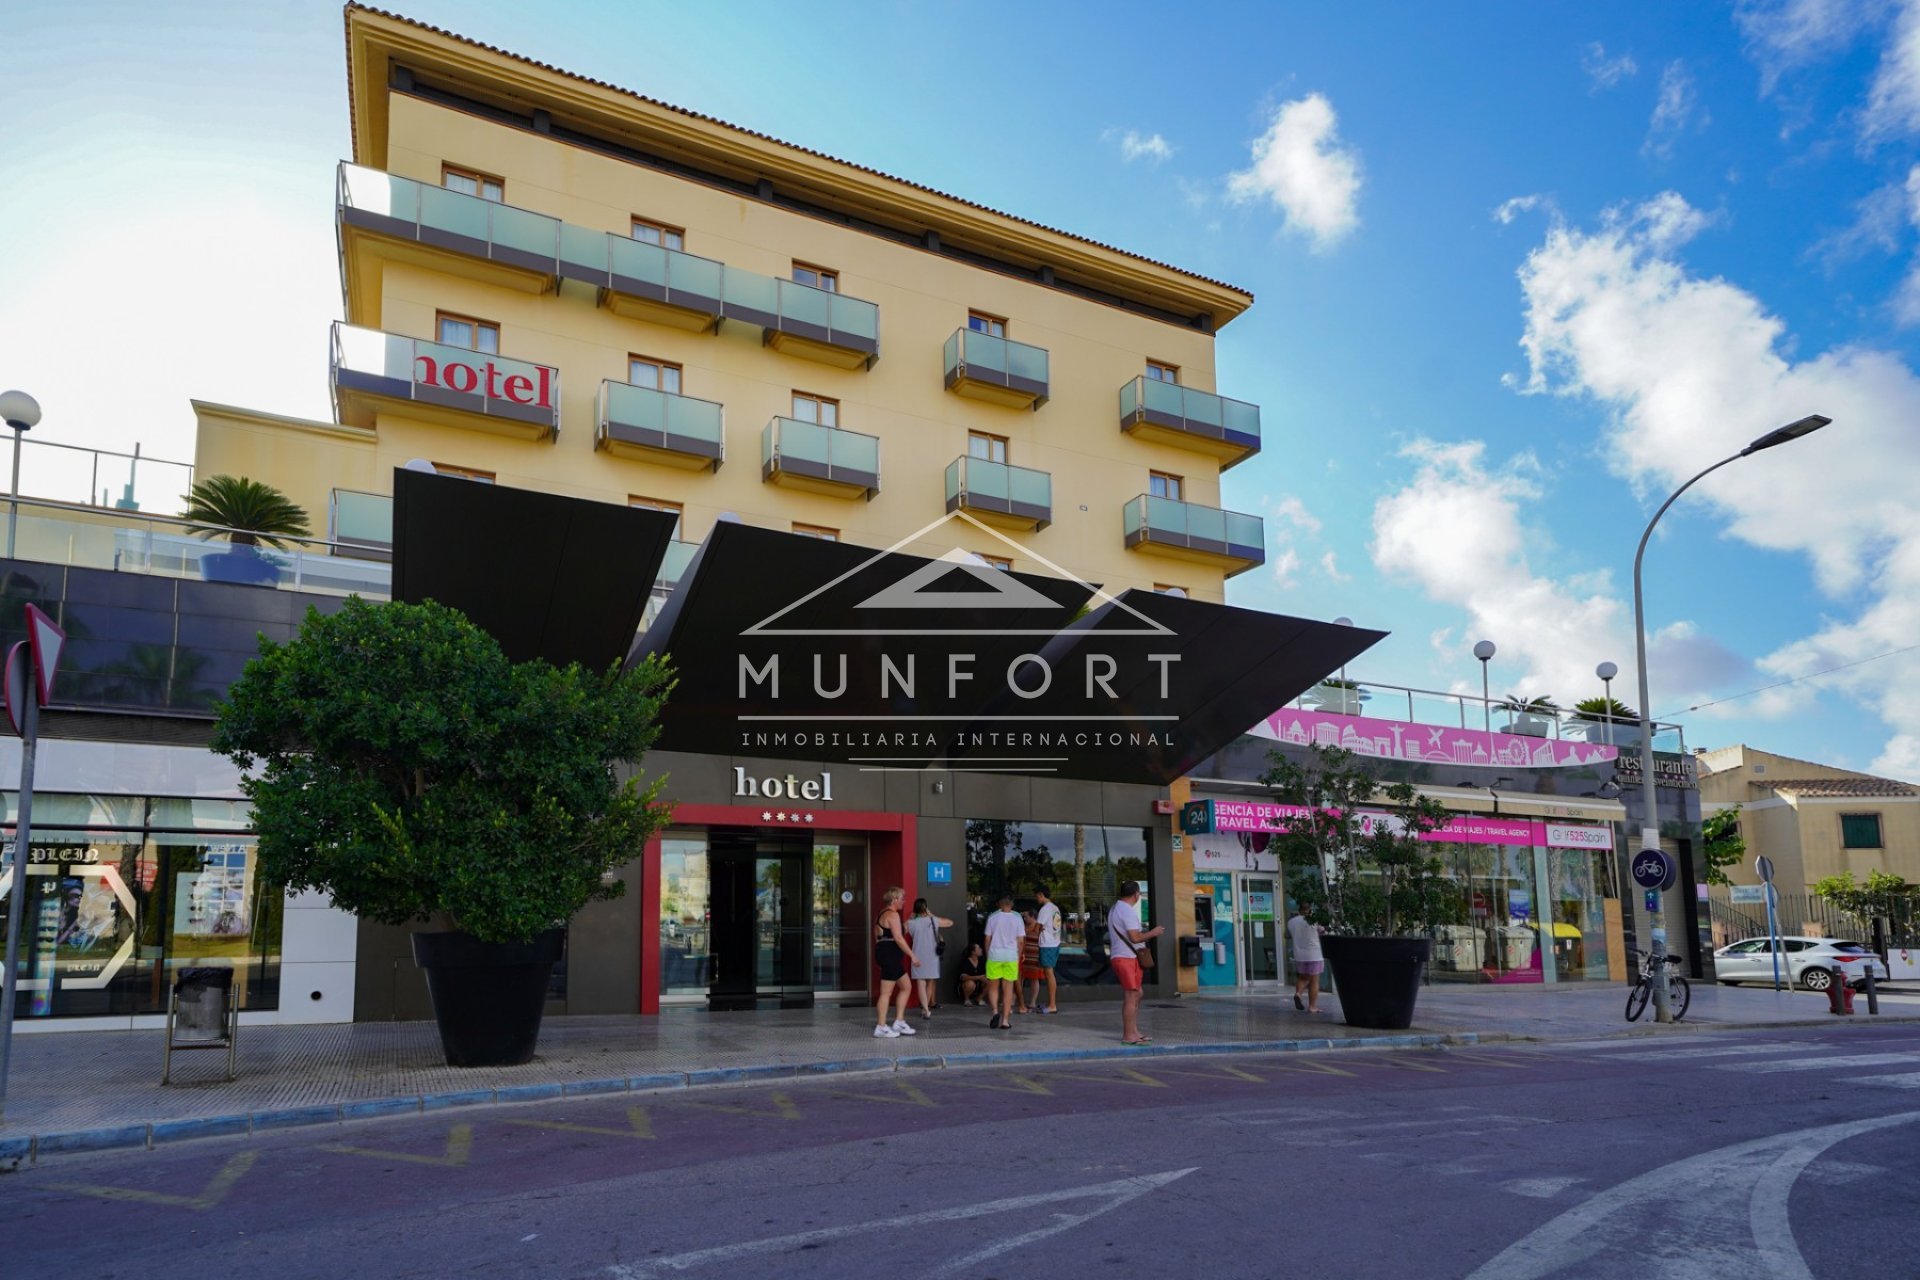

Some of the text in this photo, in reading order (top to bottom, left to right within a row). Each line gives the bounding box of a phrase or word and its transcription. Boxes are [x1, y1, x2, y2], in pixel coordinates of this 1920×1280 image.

[1618, 755, 1693, 775] resturante
[734, 766, 833, 801] hotel
[1215, 804, 1311, 819] GENCIA DE VIAJES
[1215, 816, 1256, 829] TRAVEL
[1487, 827, 1508, 836] TRAVEL
[1509, 828, 1530, 837] AGENCY
[1552, 829, 1607, 844] Glf525Spain
[29, 847, 100, 863] PLEIN
[934, 866, 944, 879] H
